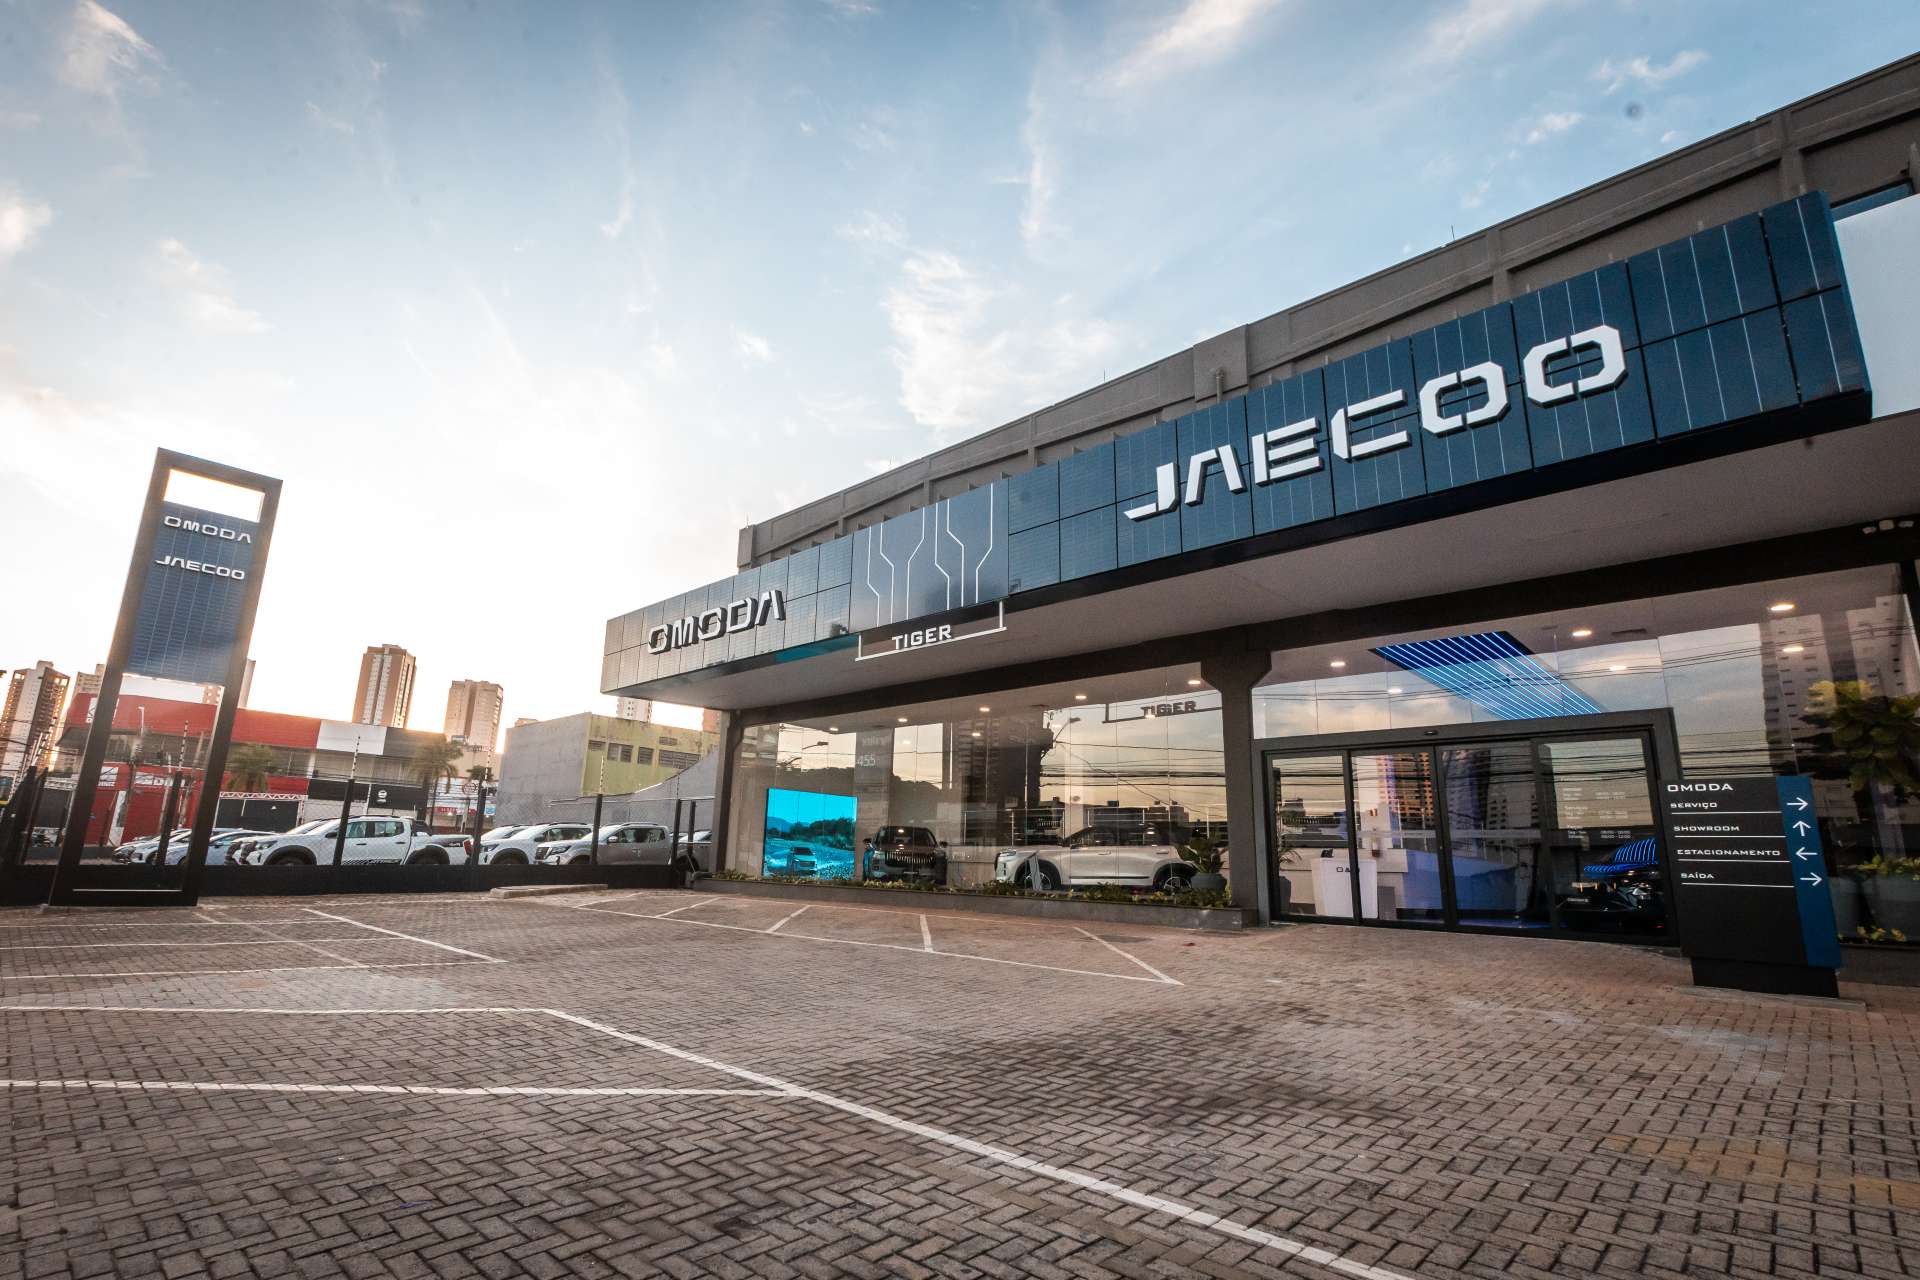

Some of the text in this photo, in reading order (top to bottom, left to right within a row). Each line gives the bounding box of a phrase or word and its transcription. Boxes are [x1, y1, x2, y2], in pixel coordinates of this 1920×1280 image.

[1123, 325, 1629, 521] JAECOO
[164, 515, 252, 544] OMODA
[155, 555, 246, 580] JAECOO
[648, 589, 786, 654] OMODA
[891, 624, 952, 650] TIGER
[1667, 783, 1734, 792] OMODA
[1670, 802, 1718, 810] SERVIÇO
